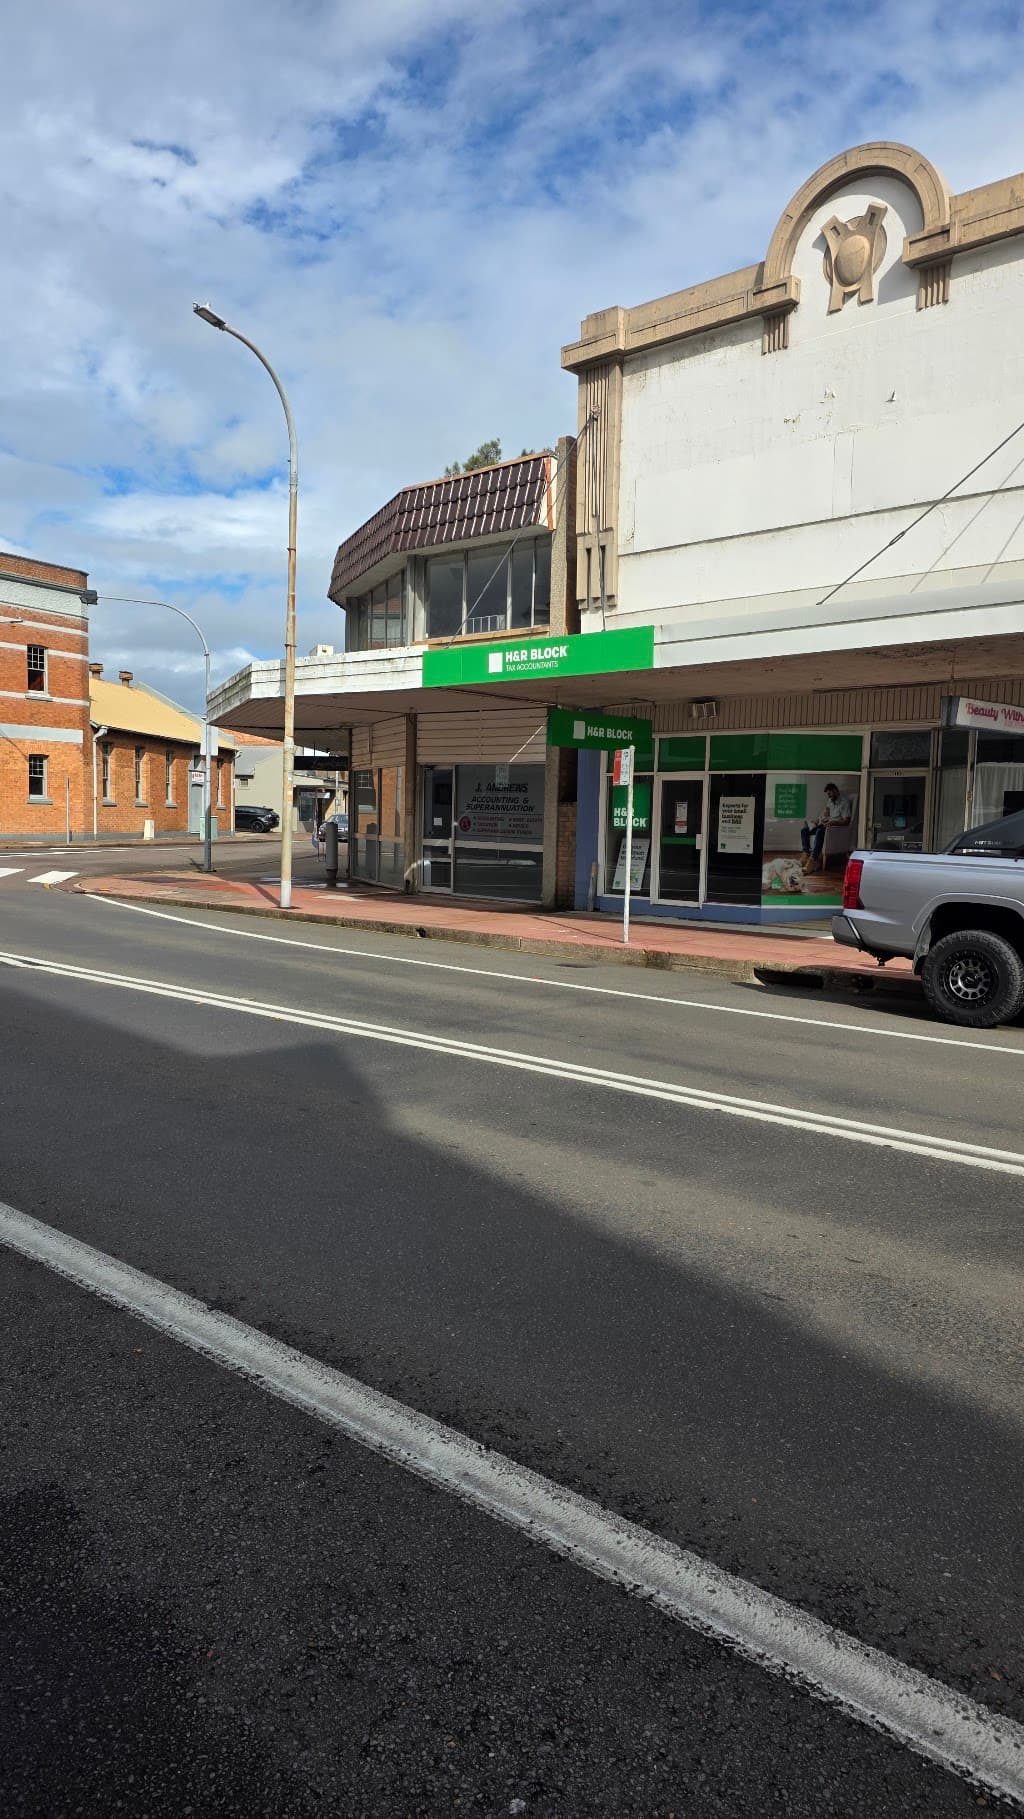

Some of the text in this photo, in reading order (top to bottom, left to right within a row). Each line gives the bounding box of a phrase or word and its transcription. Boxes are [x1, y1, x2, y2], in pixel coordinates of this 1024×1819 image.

[505, 646, 568, 663] H&R BLOCK
[506, 661, 559, 672] TAX ACCOUNTANTS
[966, 703, 999, 721] Beauty
[587, 726, 633, 741] H&R BLOCK
[486, 782, 529, 793] ANDREWS
[471, 795, 520, 804] ACCOUNTING
[465, 803, 536, 812] SUPERANNUATION
[613, 817, 648, 828] BLCK
